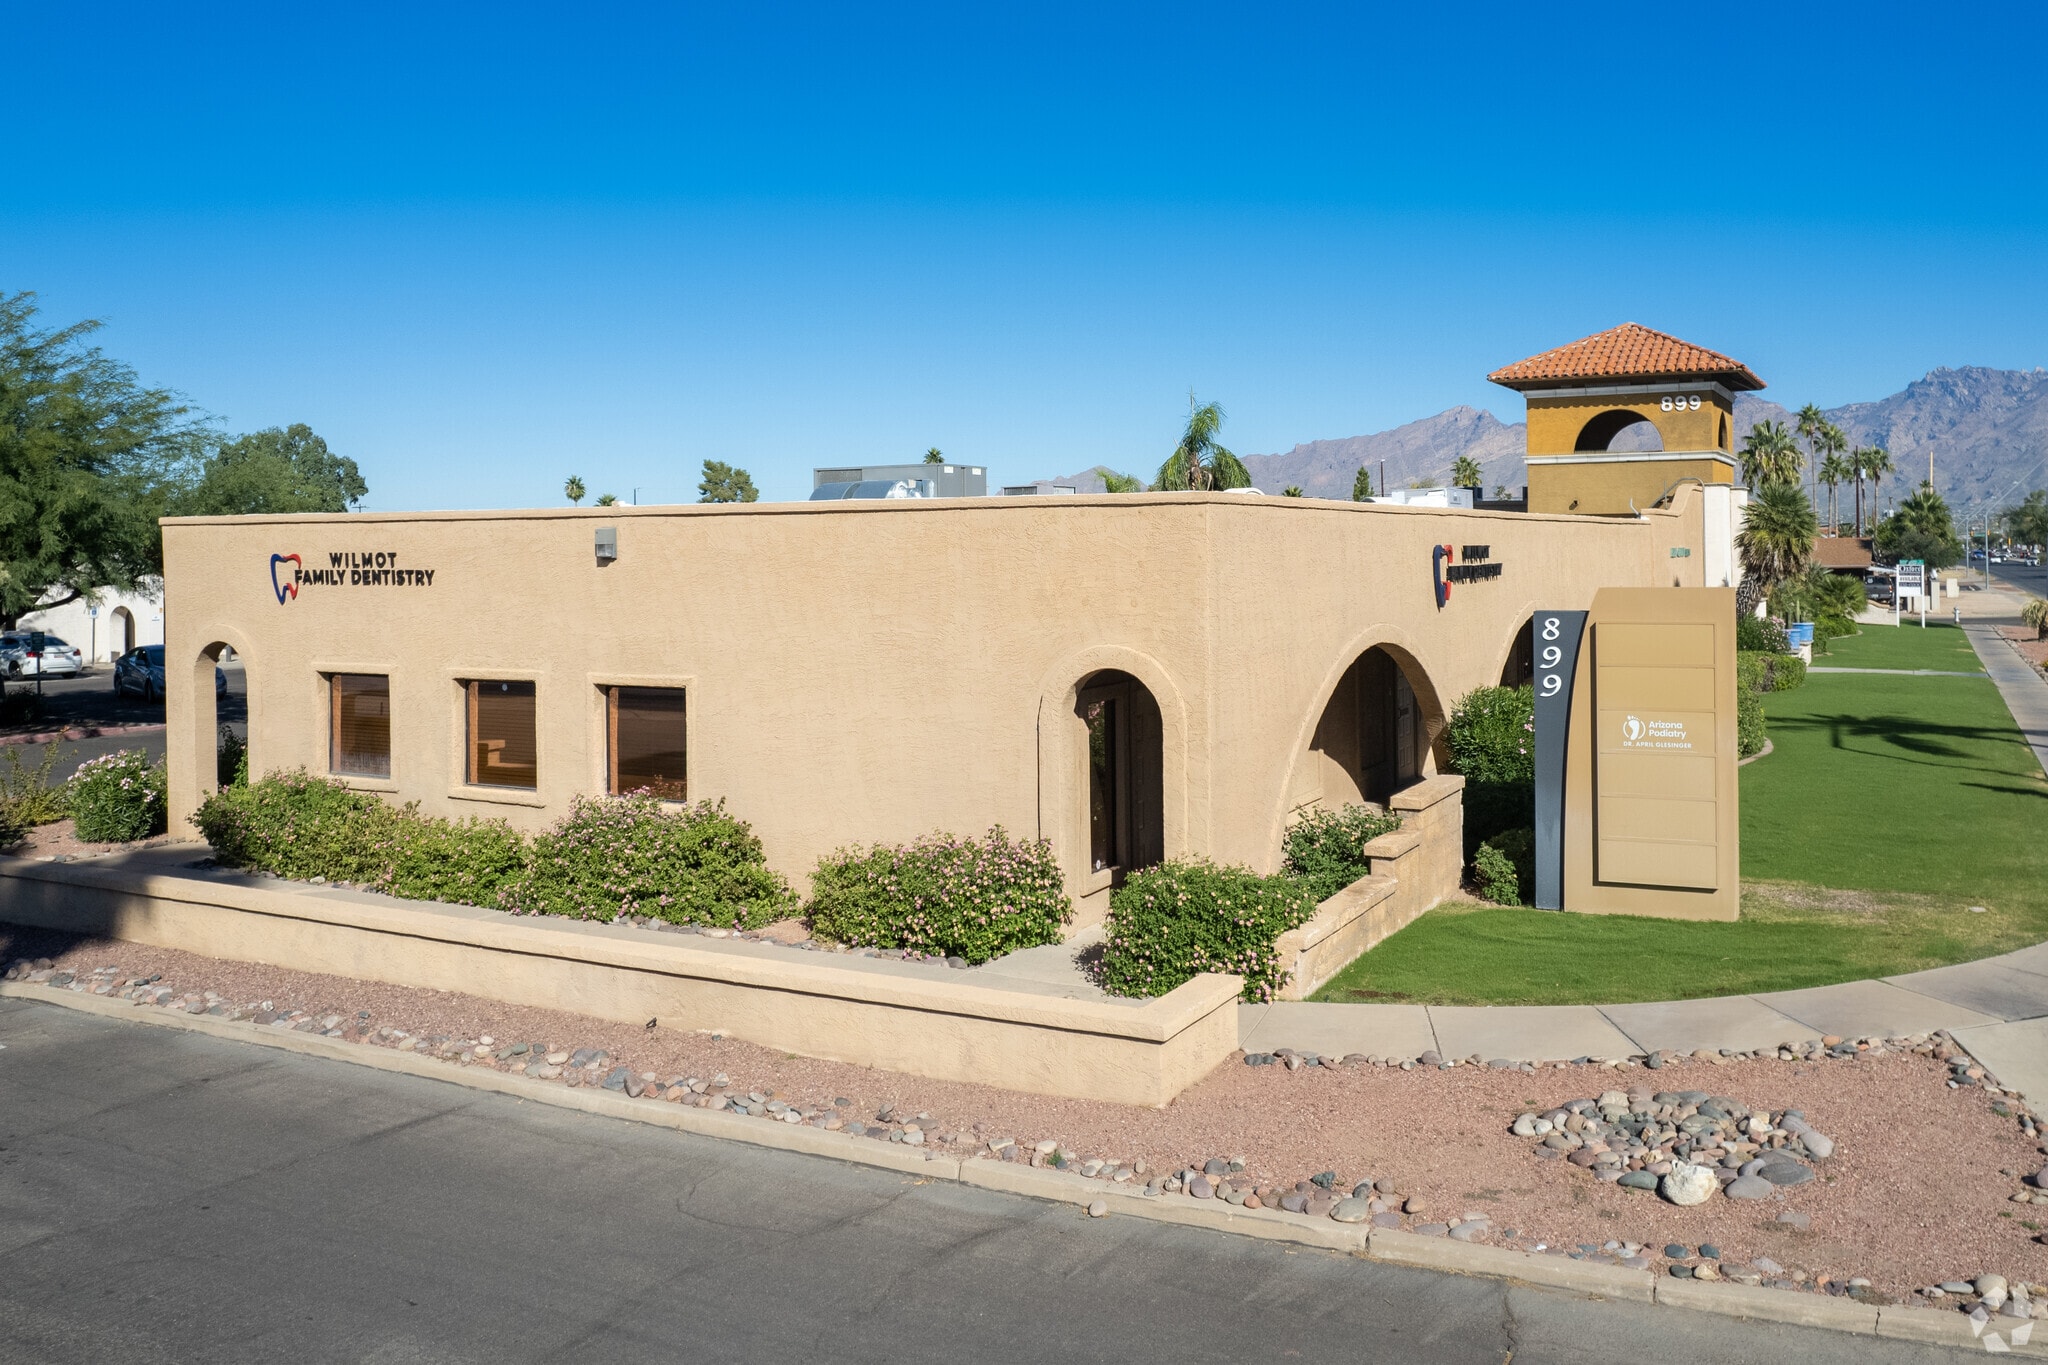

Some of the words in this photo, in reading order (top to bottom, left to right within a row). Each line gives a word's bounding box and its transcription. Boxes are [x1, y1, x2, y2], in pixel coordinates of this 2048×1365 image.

[1660, 394, 1702, 412] 899
[329, 552, 397, 569] WILMOT
[294, 570, 346, 586] FAMILY
[351, 570, 435, 586] DENTISTRY
[1540, 617, 1562, 697] 899
[1649, 721, 1683, 729] Arizona
[1649, 729, 1687, 740] Podiatry
